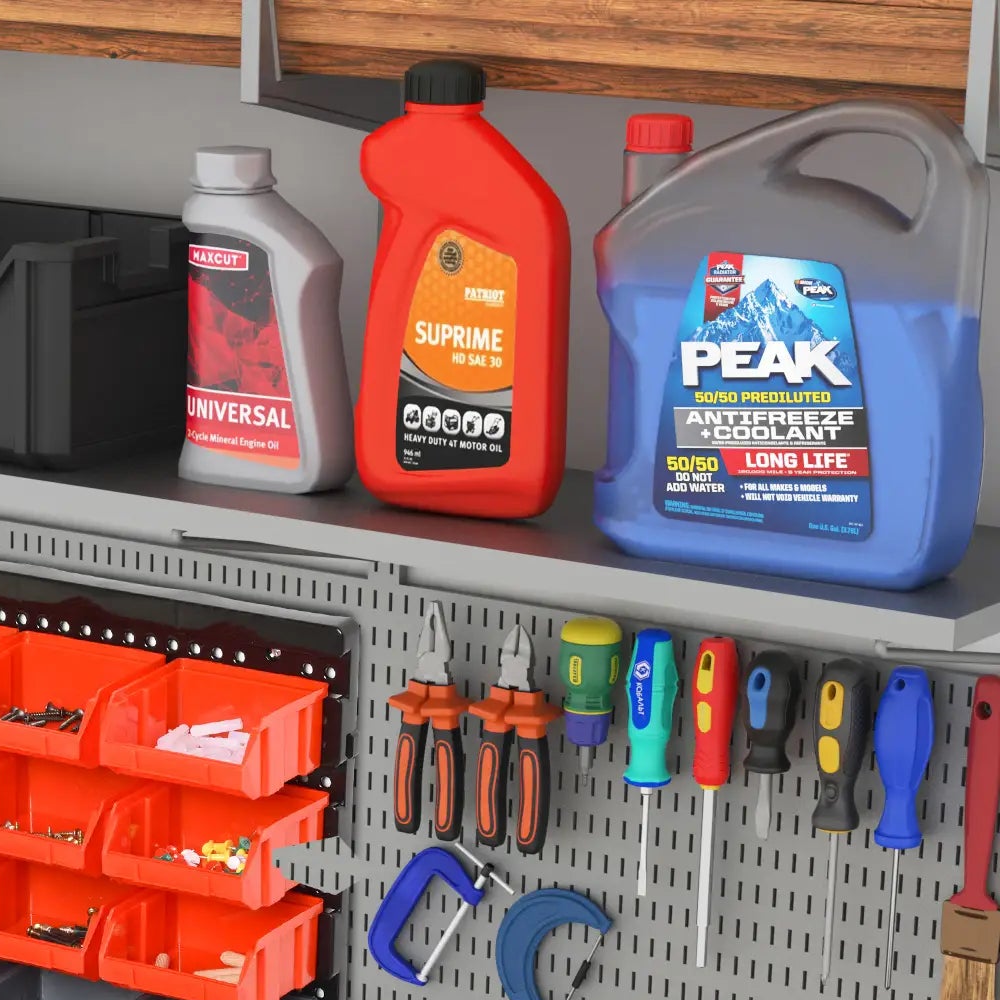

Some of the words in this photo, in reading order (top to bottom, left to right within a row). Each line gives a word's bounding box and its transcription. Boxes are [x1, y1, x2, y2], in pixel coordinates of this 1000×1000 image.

[192, 249, 239, 267] MAXCUT
[802, 285, 834, 295] PEAK
[415, 320, 504, 352] SUPRIME
[452, 353, 465, 366] HD
[468, 354, 487, 368] SAE
[489, 355, 503, 369] 30
[680, 340, 852, 386] PEAK
[694, 391, 738, 404] 50/50
[741, 391, 831, 403] PREDILUTED
[187, 395, 292, 430] UNIVERSAL
[686, 410, 854, 425] ANTIFREEZE
[209, 433, 238, 445] Mineral
[239, 437, 266, 449] Engine
[267, 440, 279, 450] Oil
[403, 432, 427, 444] HEAVY
[428, 436, 448, 447] DUTY
[448, 439, 458, 448] 4T
[459, 440, 487, 452] MOTOR
[489, 443, 503, 453] OIL
[666, 455, 719, 472] 50/50
[745, 452, 798, 469] LONG
[803, 452, 848, 469] LIFE
[676, 472, 690, 482] DO
[692, 472, 713, 483] NOT
[666, 482, 691, 492] ADD
[690, 483, 725, 493] WATER
[744, 483, 757, 491] FOR
[758, 483, 769, 491] ALL
[770, 483, 793, 491] MAKES
[799, 484, 827, 492] MODELS
[745, 492, 761, 501] WILL
[762, 493, 775, 501] NOT
[776, 493, 793, 502] VOID
[793, 494, 821, 502] VEHICLE
[821, 494, 858, 503] WARRANTY
[635, 682, 645, 715] КОБАЛЬТ
